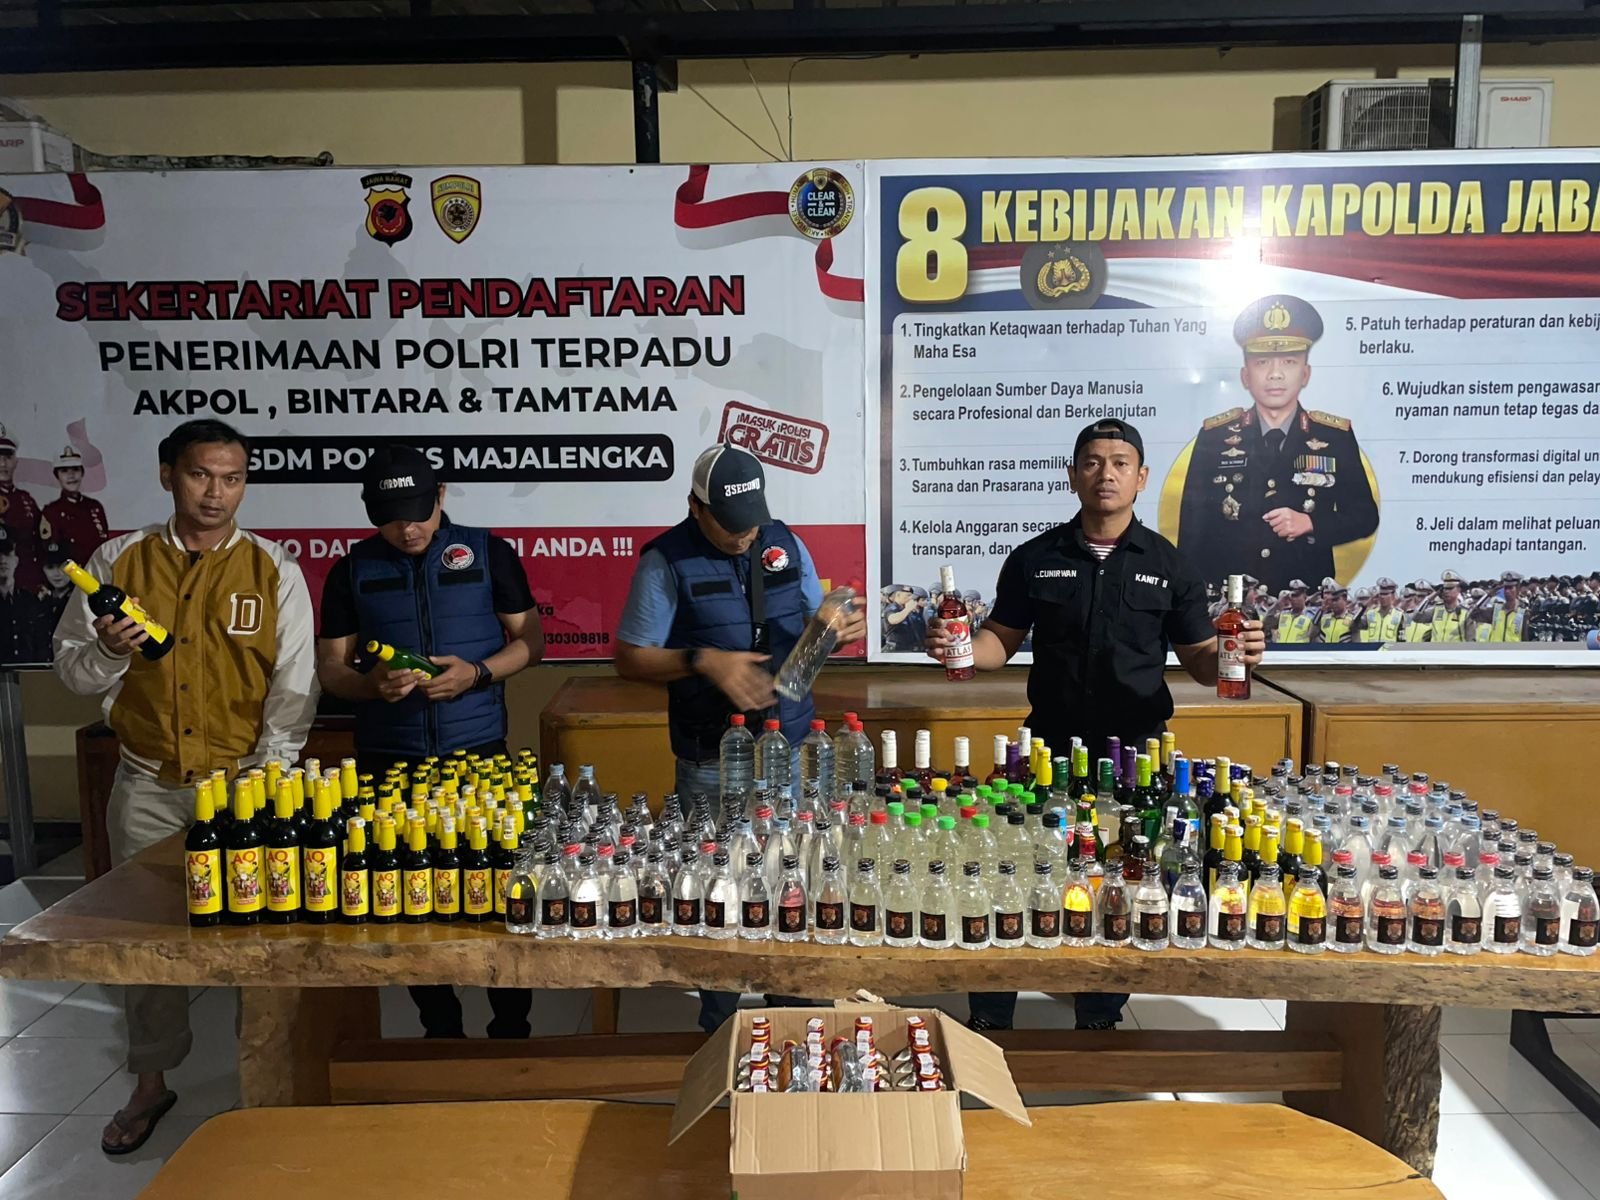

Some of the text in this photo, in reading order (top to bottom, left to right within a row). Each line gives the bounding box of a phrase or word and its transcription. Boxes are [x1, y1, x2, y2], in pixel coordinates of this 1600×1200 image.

[0, 139, 25, 148] ARP
[807, 191, 835, 200] CLEAR
[807, 207, 836, 217] CLEAN
[896, 187, 968, 304] 8
[981, 186, 1244, 243] KEBIJAKAN
[1260, 181, 1485, 238] KAPOLDA
[56, 275, 745, 322] SEKERTARIAT PENDAFTARAN
[901, 318, 1206, 340] 1. Tingkatkan Ketaqwaan terhadap Tuhan Yang
[1346, 317, 1356, 331] 5.
[1361, 316, 1400, 330] Patuh
[1405, 315, 1466, 332] terhadap
[1470, 316, 1534, 332] peraturan
[1540, 314, 1564, 327] dan
[99, 336, 731, 371] PENERIMAAN POLRI TERPADU
[914, 344, 976, 358] Maha Esa
[1360, 340, 1413, 354] berlaku.
[900, 381, 1143, 401] 2. Pengelolaan Sumber Daya Manusia
[1383, 382, 1393, 395] 6.
[1397, 381, 1464, 398] Wujudkan
[1469, 381, 1513, 394] sistem
[133, 389, 258, 415] AKPOL
[288, 387, 450, 413] BINTARA
[460, 387, 482, 413] &
[492, 386, 678, 412] TAMTAMA
[913, 404, 1156, 420] secara Profesional dan Berkelanjutan
[1396, 406, 1448, 420] nyaman
[1454, 406, 1499, 416] namun
[1504, 403, 1537, 418] tetap
[1542, 403, 1578, 418] tegas
[726, 423, 815, 465] GRATIS
[248, 445, 668, 471] SDM POS MAJALENGKA
[900, 456, 1073, 471] 3. Tumbuhkan rasa memiliki
[1400, 451, 1408, 463] 7.
[1414, 451, 1458, 466] Dorong
[1462, 450, 1539, 462] transformasi
[1543, 450, 1580, 465] digital
[379, 475, 416, 490] CARDINAL
[912, 479, 1076, 494] Sarana dan Prasarana yan
[1412, 471, 1483, 486] mendukung
[1488, 471, 1538, 483] efisiensi
[1543, 471, 1564, 482] dan
[724, 477, 761, 497] 3SECOND
[900, 520, 910, 533] 4.
[913, 520, 952, 533] Kelola
[956, 520, 1018, 536] Anggaran
[1417, 517, 1427, 530] 8.
[1430, 517, 1453, 530] Jeli
[1458, 517, 1497, 530] dalam
[1503, 517, 1551, 529] melihat
[531, 537, 606, 557] ANDA
[612, 537, 633, 556] !!!
[913, 544, 984, 558] transparan,
[989, 542, 1012, 554] dan
[1429, 538, 1586, 554] menghadapi tantangan.
[1135, 573, 1160, 586] KANIT
[227, 592, 264, 635] D
[946, 646, 972, 657] ATLAS
[231, 850, 257, 865] AO
[267, 850, 289, 863] AO
[305, 850, 325, 863] AO
